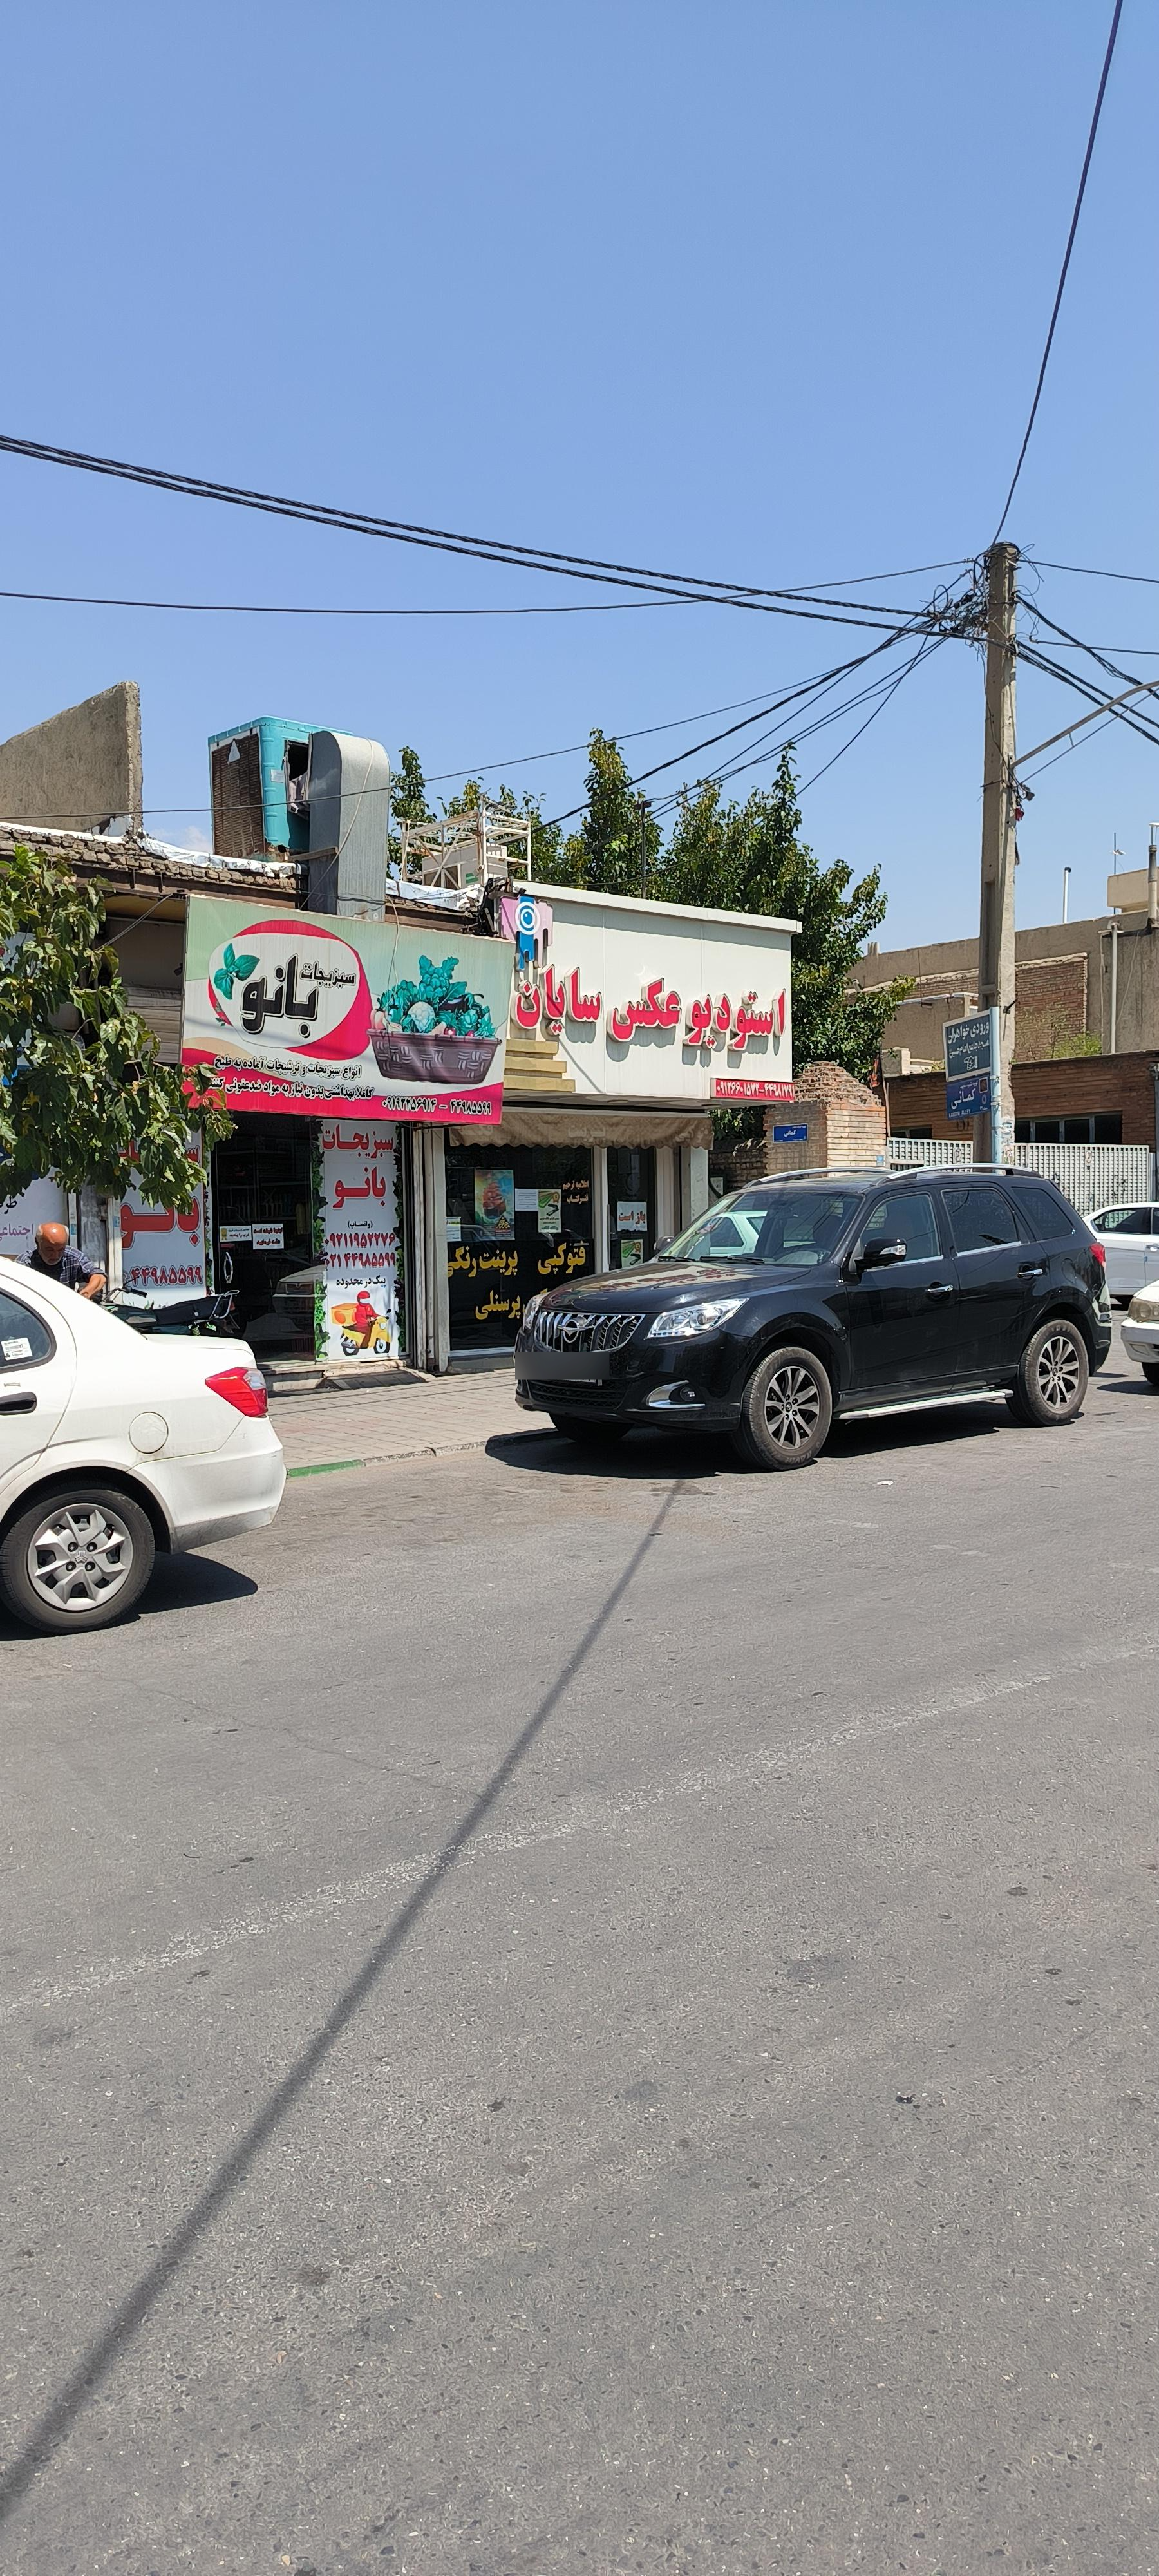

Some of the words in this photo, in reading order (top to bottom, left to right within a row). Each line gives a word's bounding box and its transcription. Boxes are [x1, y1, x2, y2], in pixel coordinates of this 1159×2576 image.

[299, 960, 356, 989] سبزیجات
[240, 953, 319, 1038] بانو
[512, 964, 601, 1036] سایان
[607, 978, 681, 1042] عکس
[684, 989, 786, 1051] استودیو
[214, 1054, 233, 1068] طبخ
[234, 1059, 243, 1072] به
[243, 1057, 266, 1070] آماده
[301, 1065, 306, 1077] و
[308, 1063, 341, 1079] سبزیجات
[342, 1064, 362, 1081] انواع
[263, 1081, 280, 1096] مواد
[281, 1083, 290, 1097] به
[290, 1082, 303, 1097] نیاز
[304, 1084, 325, 1099] بدون
[951, 1087, 976, 1110] کمانی
[449, 1099, 491, 1115] ۴۴۹۸۵۵۹۹
[322, 1124, 393, 1159] سبزیجات
[332, 1166, 386, 1208] بانو
[619, 1211, 634, 1222] است
[636, 1211, 646, 1225] باز
[479, 1249, 518, 1276] پرینت
[538, 1240, 585, 1274] فتوکپی
[336, 1278, 363, 1289] محدوده
[364, 1277, 372, 1288] در
[373, 1275, 386, 1288] پیک
[475, 1289, 521, 1320] پرسنلی
